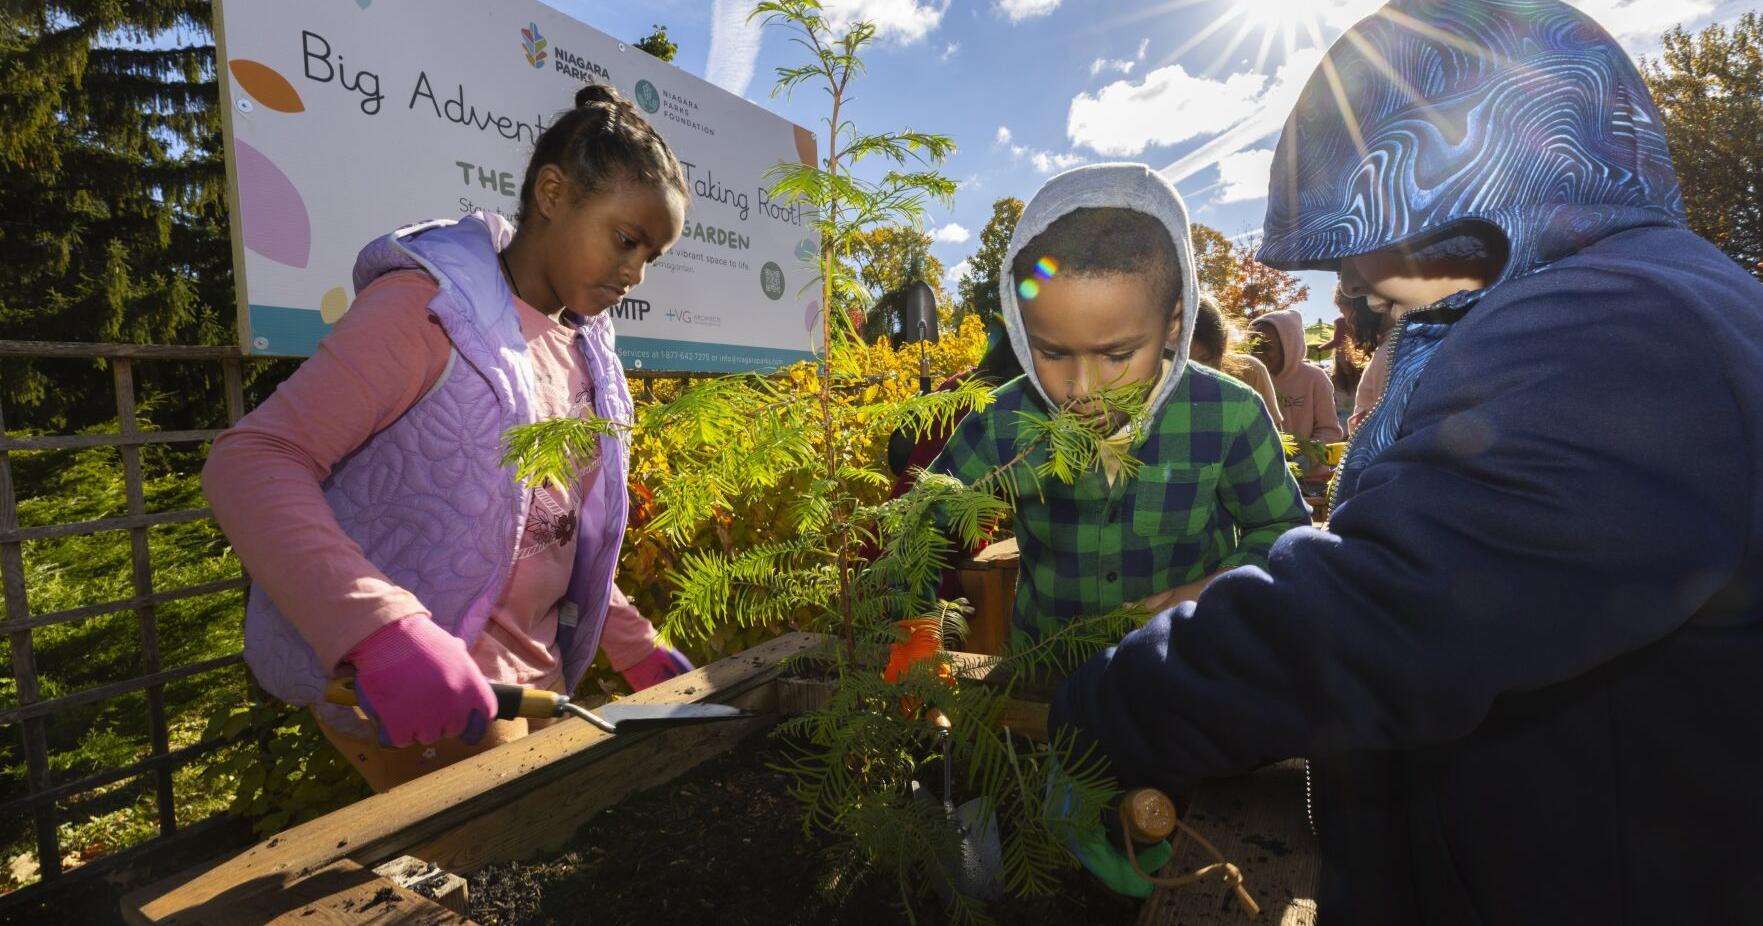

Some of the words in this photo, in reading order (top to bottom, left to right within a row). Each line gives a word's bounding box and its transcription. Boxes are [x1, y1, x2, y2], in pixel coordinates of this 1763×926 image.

[554, 46, 610, 80] NIAGARA
[662, 89, 699, 110] NIAGARA
[663, 100, 689, 116] PARKS
[302, 30, 384, 115] Big
[409, 71, 550, 146] Advent
[680, 160, 749, 221] Taking
[758, 187, 801, 227] Root!
[664, 110, 715, 136] FOUNDATION
[456, 161, 516, 197] THE
[682, 220, 750, 250] GARDEN
[459, 197, 490, 214] Sta
[675, 249, 704, 262] vibrant
[706, 255, 728, 266] space
[729, 260, 737, 268] to
[617, 347, 650, 358] Services
